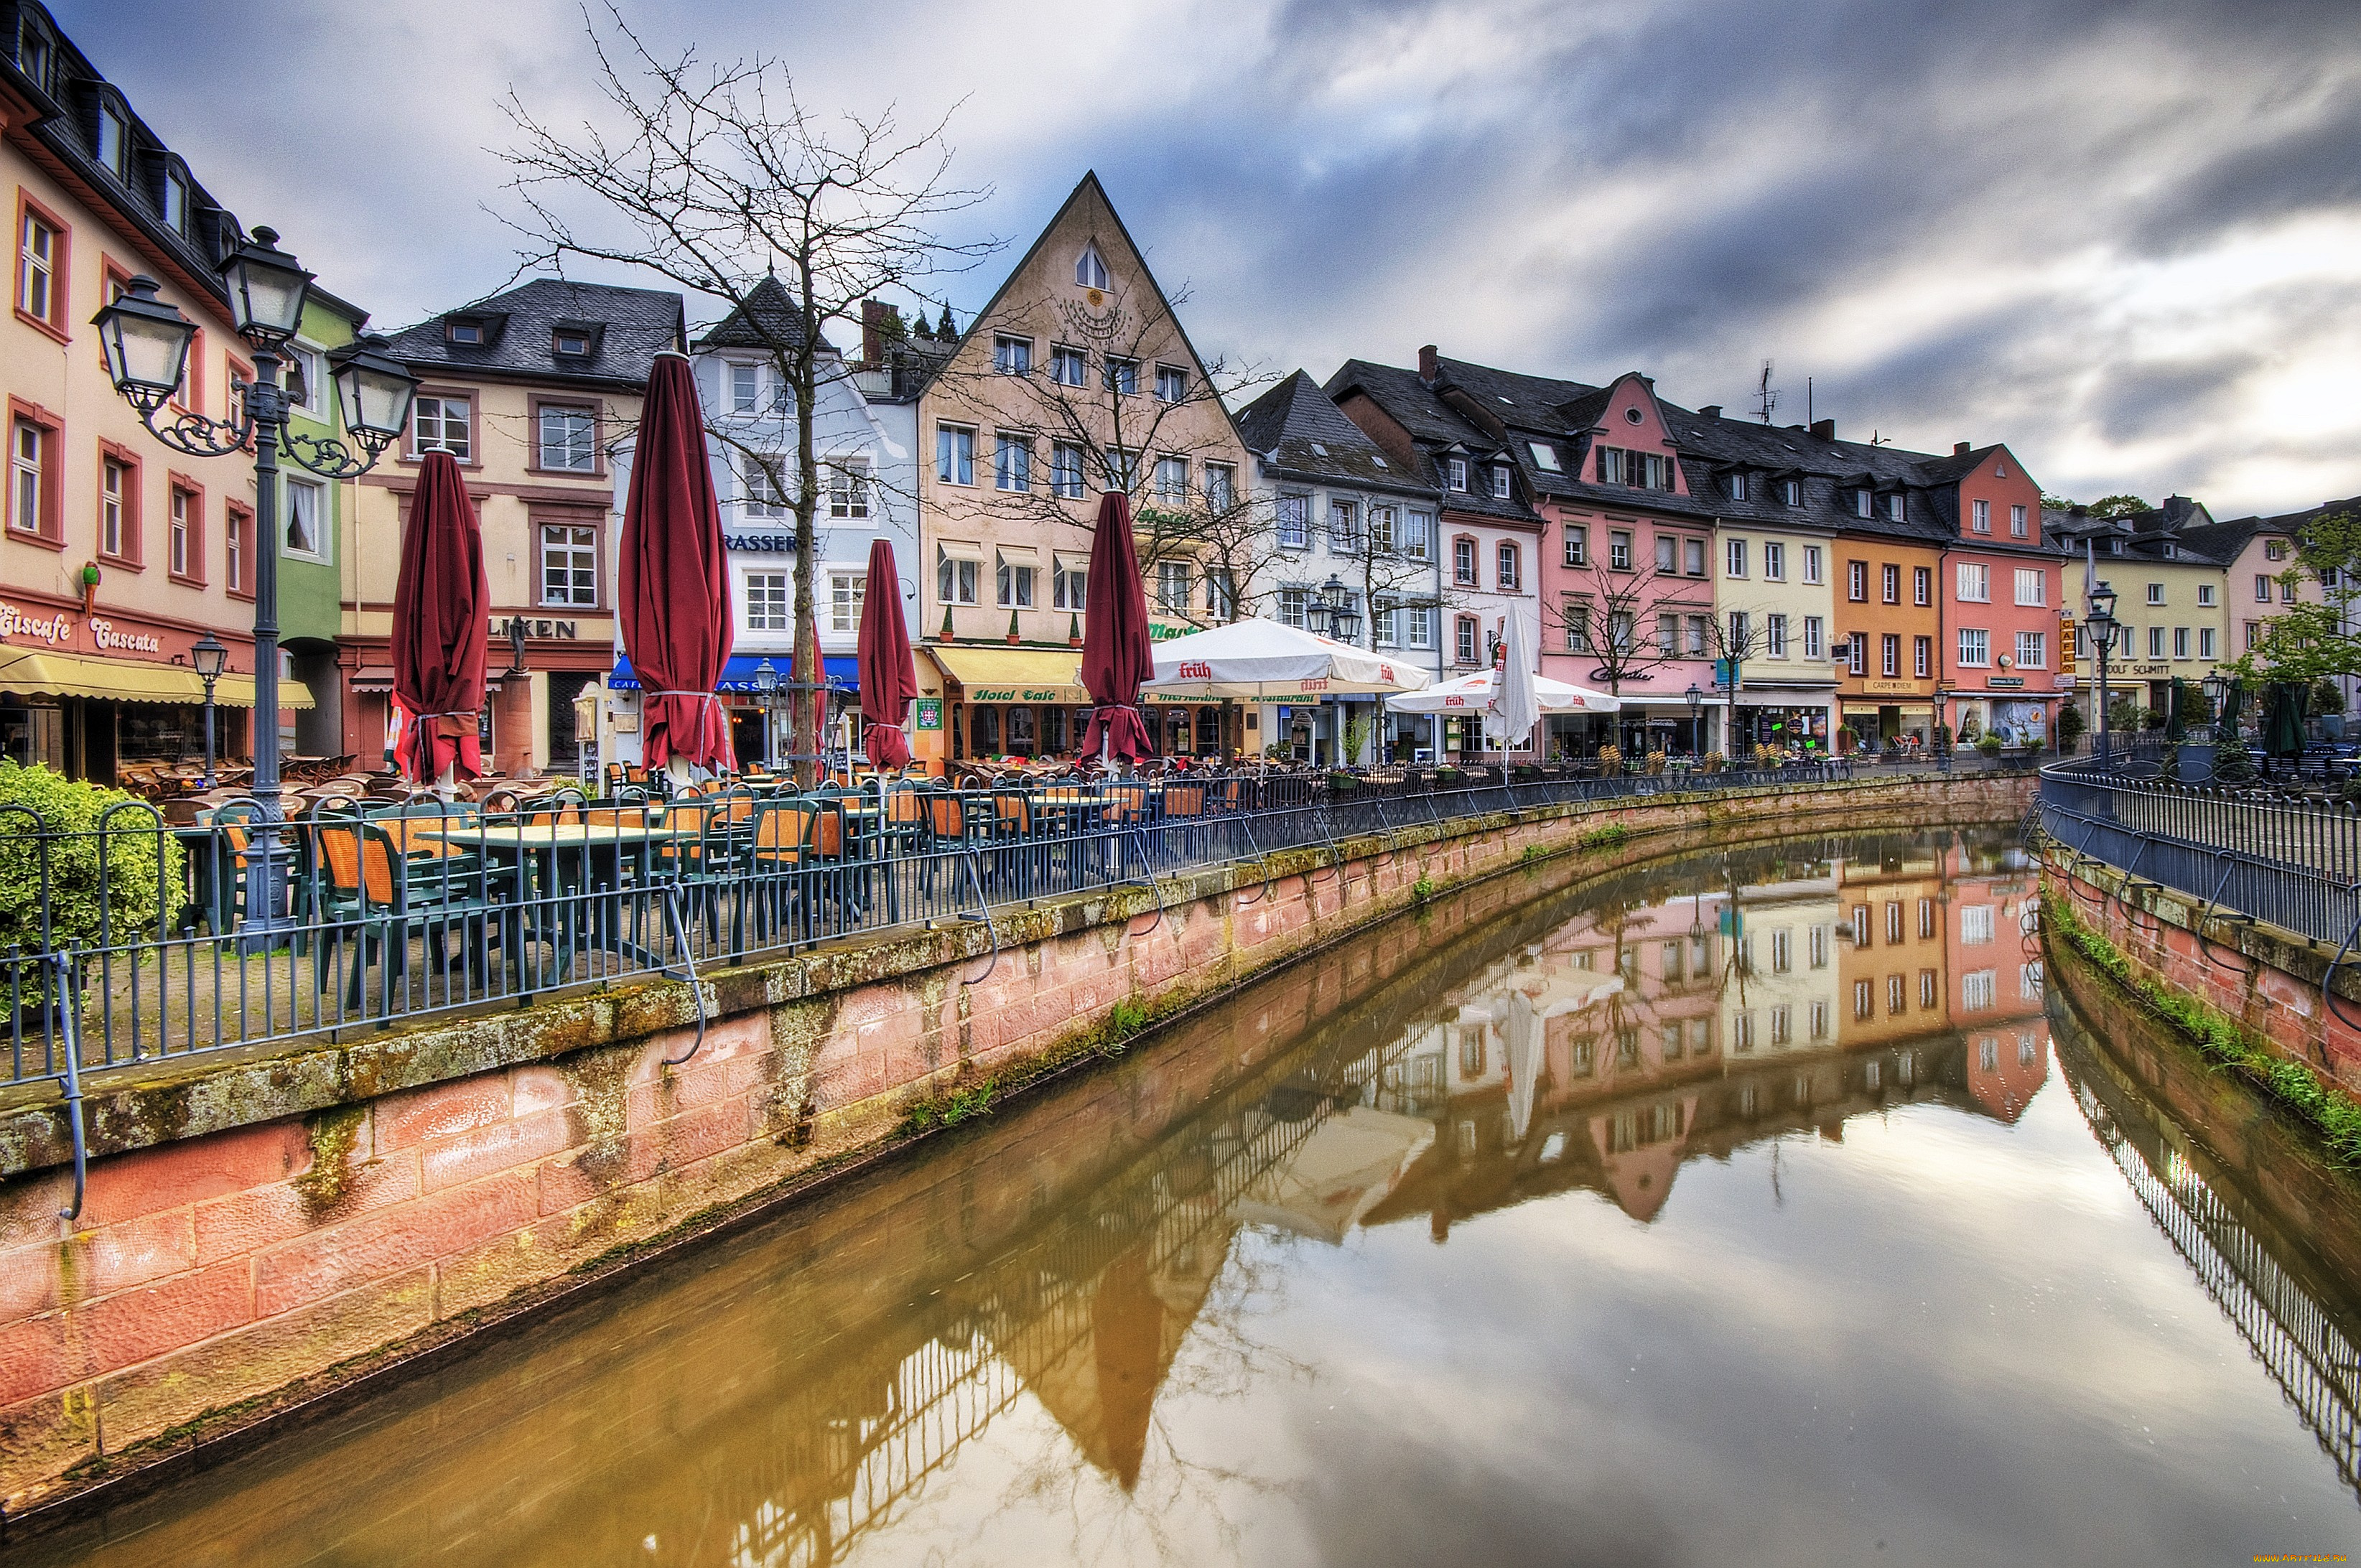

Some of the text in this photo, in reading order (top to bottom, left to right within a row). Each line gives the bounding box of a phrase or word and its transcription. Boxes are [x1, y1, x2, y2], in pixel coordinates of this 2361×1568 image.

[89, 617, 159, 653] Cascata
[1178, 661, 1211, 680] früh
[1380, 663, 1394, 683] früh
[2133, 665, 2170, 675] SCHMITT
[973, 689, 1056, 701] Hotel Café
[1445, 696, 1464, 706] früh
